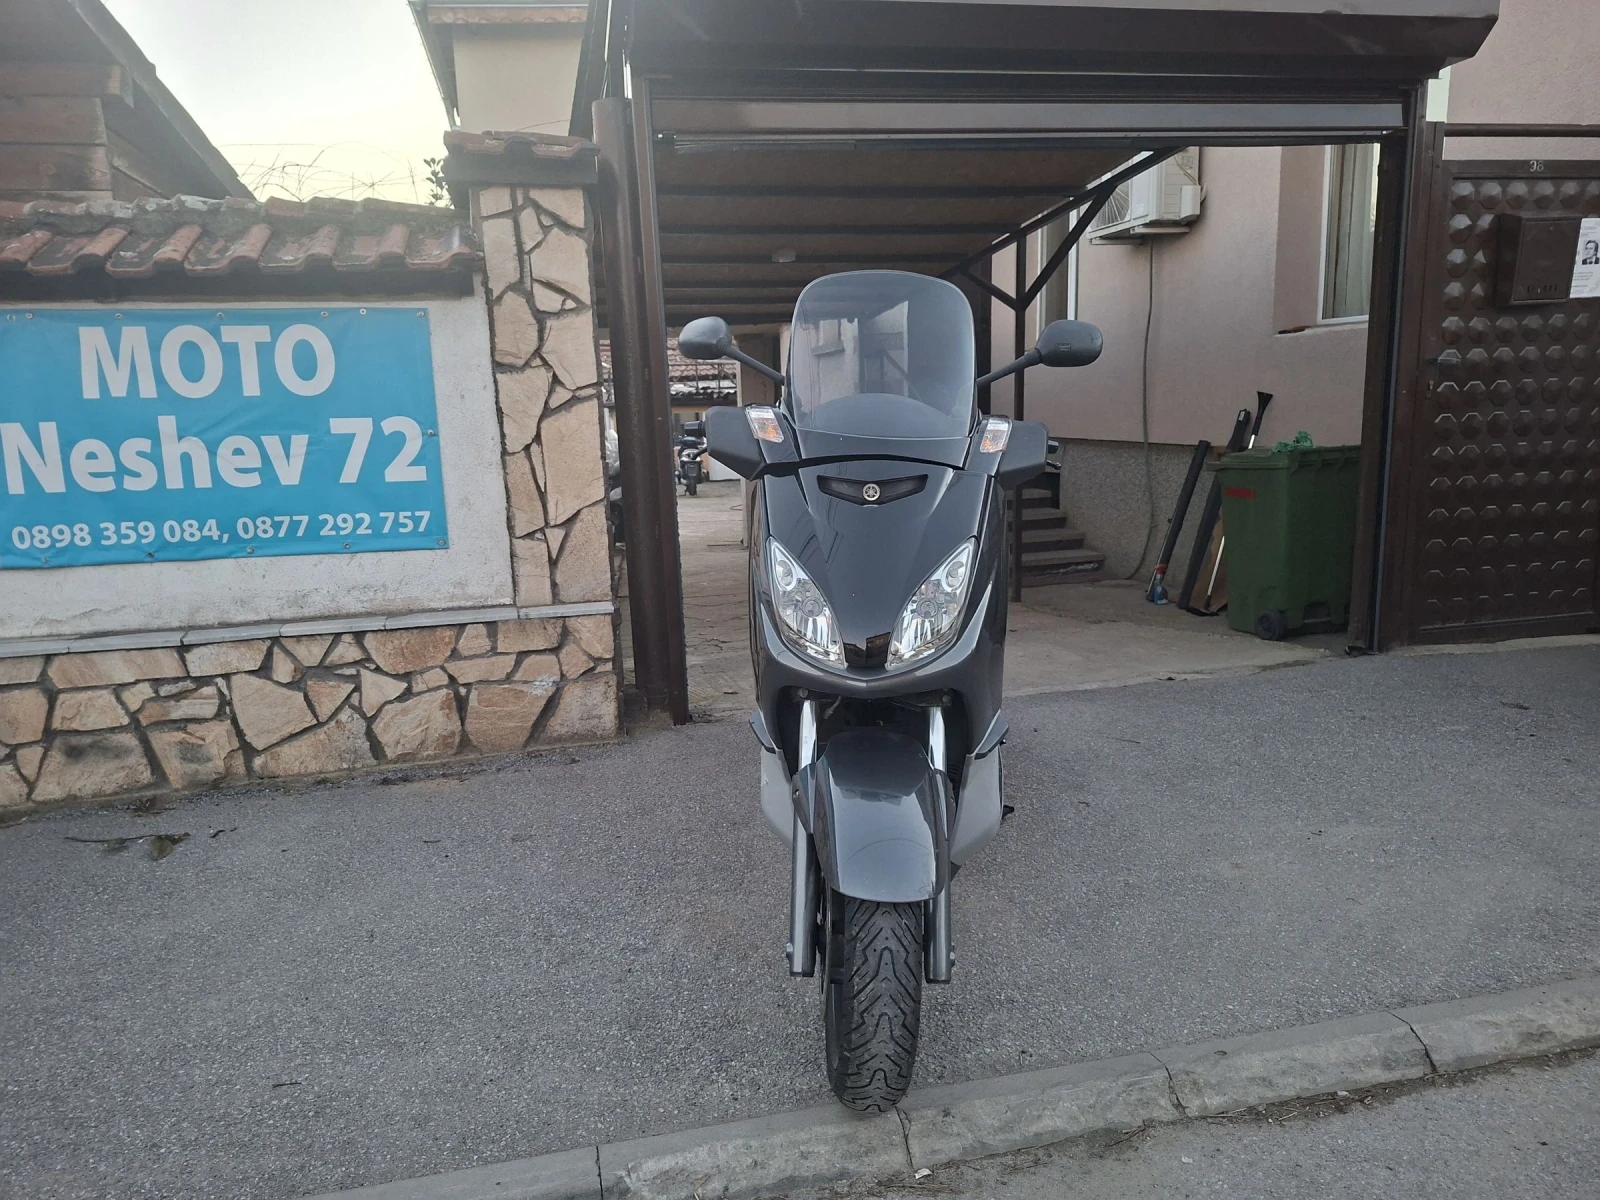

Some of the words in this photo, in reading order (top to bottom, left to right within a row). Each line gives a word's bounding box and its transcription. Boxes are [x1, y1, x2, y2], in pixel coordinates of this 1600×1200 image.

[79, 324, 335, 399] MOTO
[0, 416, 309, 494] Neshev
[329, 416, 428, 483] 72
[11, 523, 91, 549] 0898
[100, 521, 156, 546] 359
[163, 518, 230, 543] 084,
[237, 516, 309, 539] 0877
[318, 512, 372, 535] 292
[379, 510, 431, 534] 757
